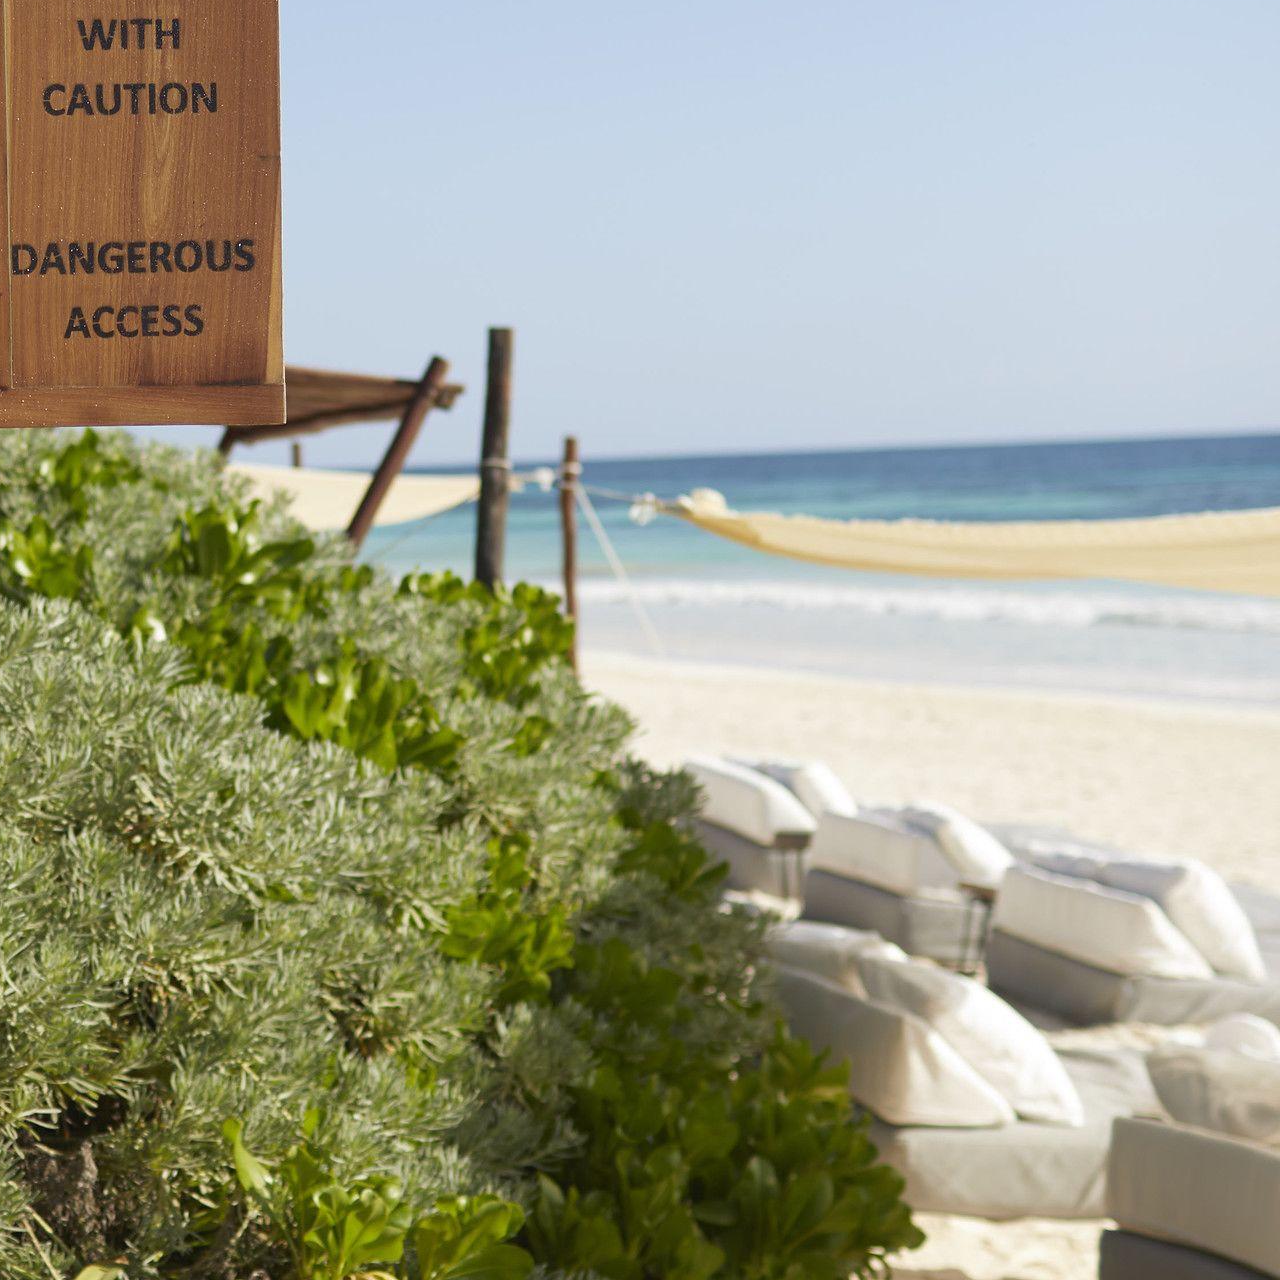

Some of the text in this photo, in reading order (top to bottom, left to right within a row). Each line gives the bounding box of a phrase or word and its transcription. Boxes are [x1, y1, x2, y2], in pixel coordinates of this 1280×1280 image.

[78, 19, 181, 52] WITH
[44, 83, 219, 117] CAUTION
[12, 239, 257, 276] DANGEROUS
[65, 305, 205, 340] ACCESS
